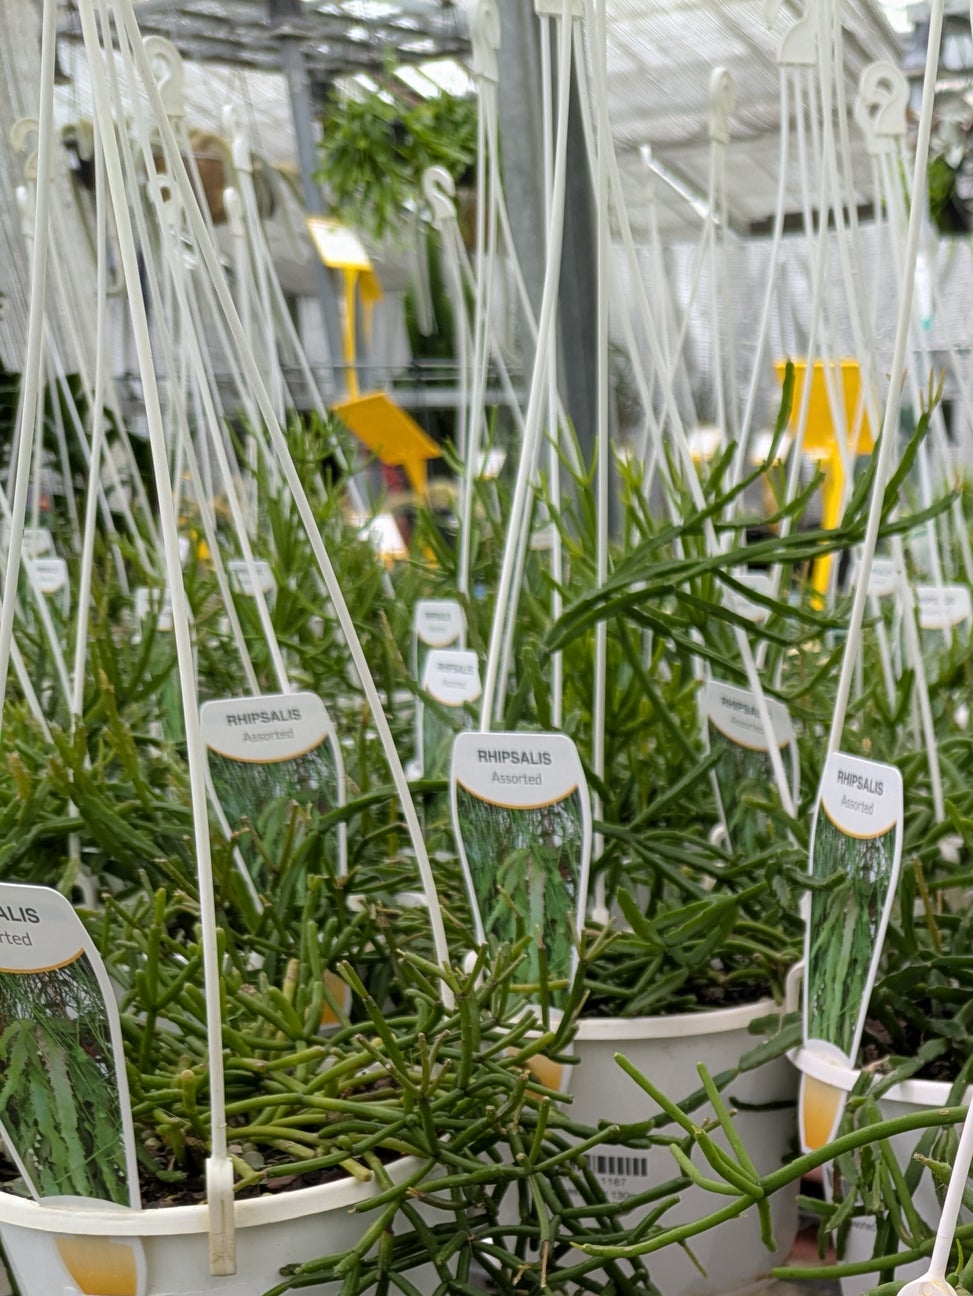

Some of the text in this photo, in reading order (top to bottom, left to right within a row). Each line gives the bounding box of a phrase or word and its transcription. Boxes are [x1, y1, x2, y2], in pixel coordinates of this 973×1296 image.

[226, 709, 302, 726] RHIPSALIS
[242, 729, 295, 742] Assorted
[478, 750, 552, 765] RHIPSALIS
[491, 771, 543, 785] Assorted
[837, 769, 884, 796] RHIPSALIS
[841, 794, 874, 815] Assorted
